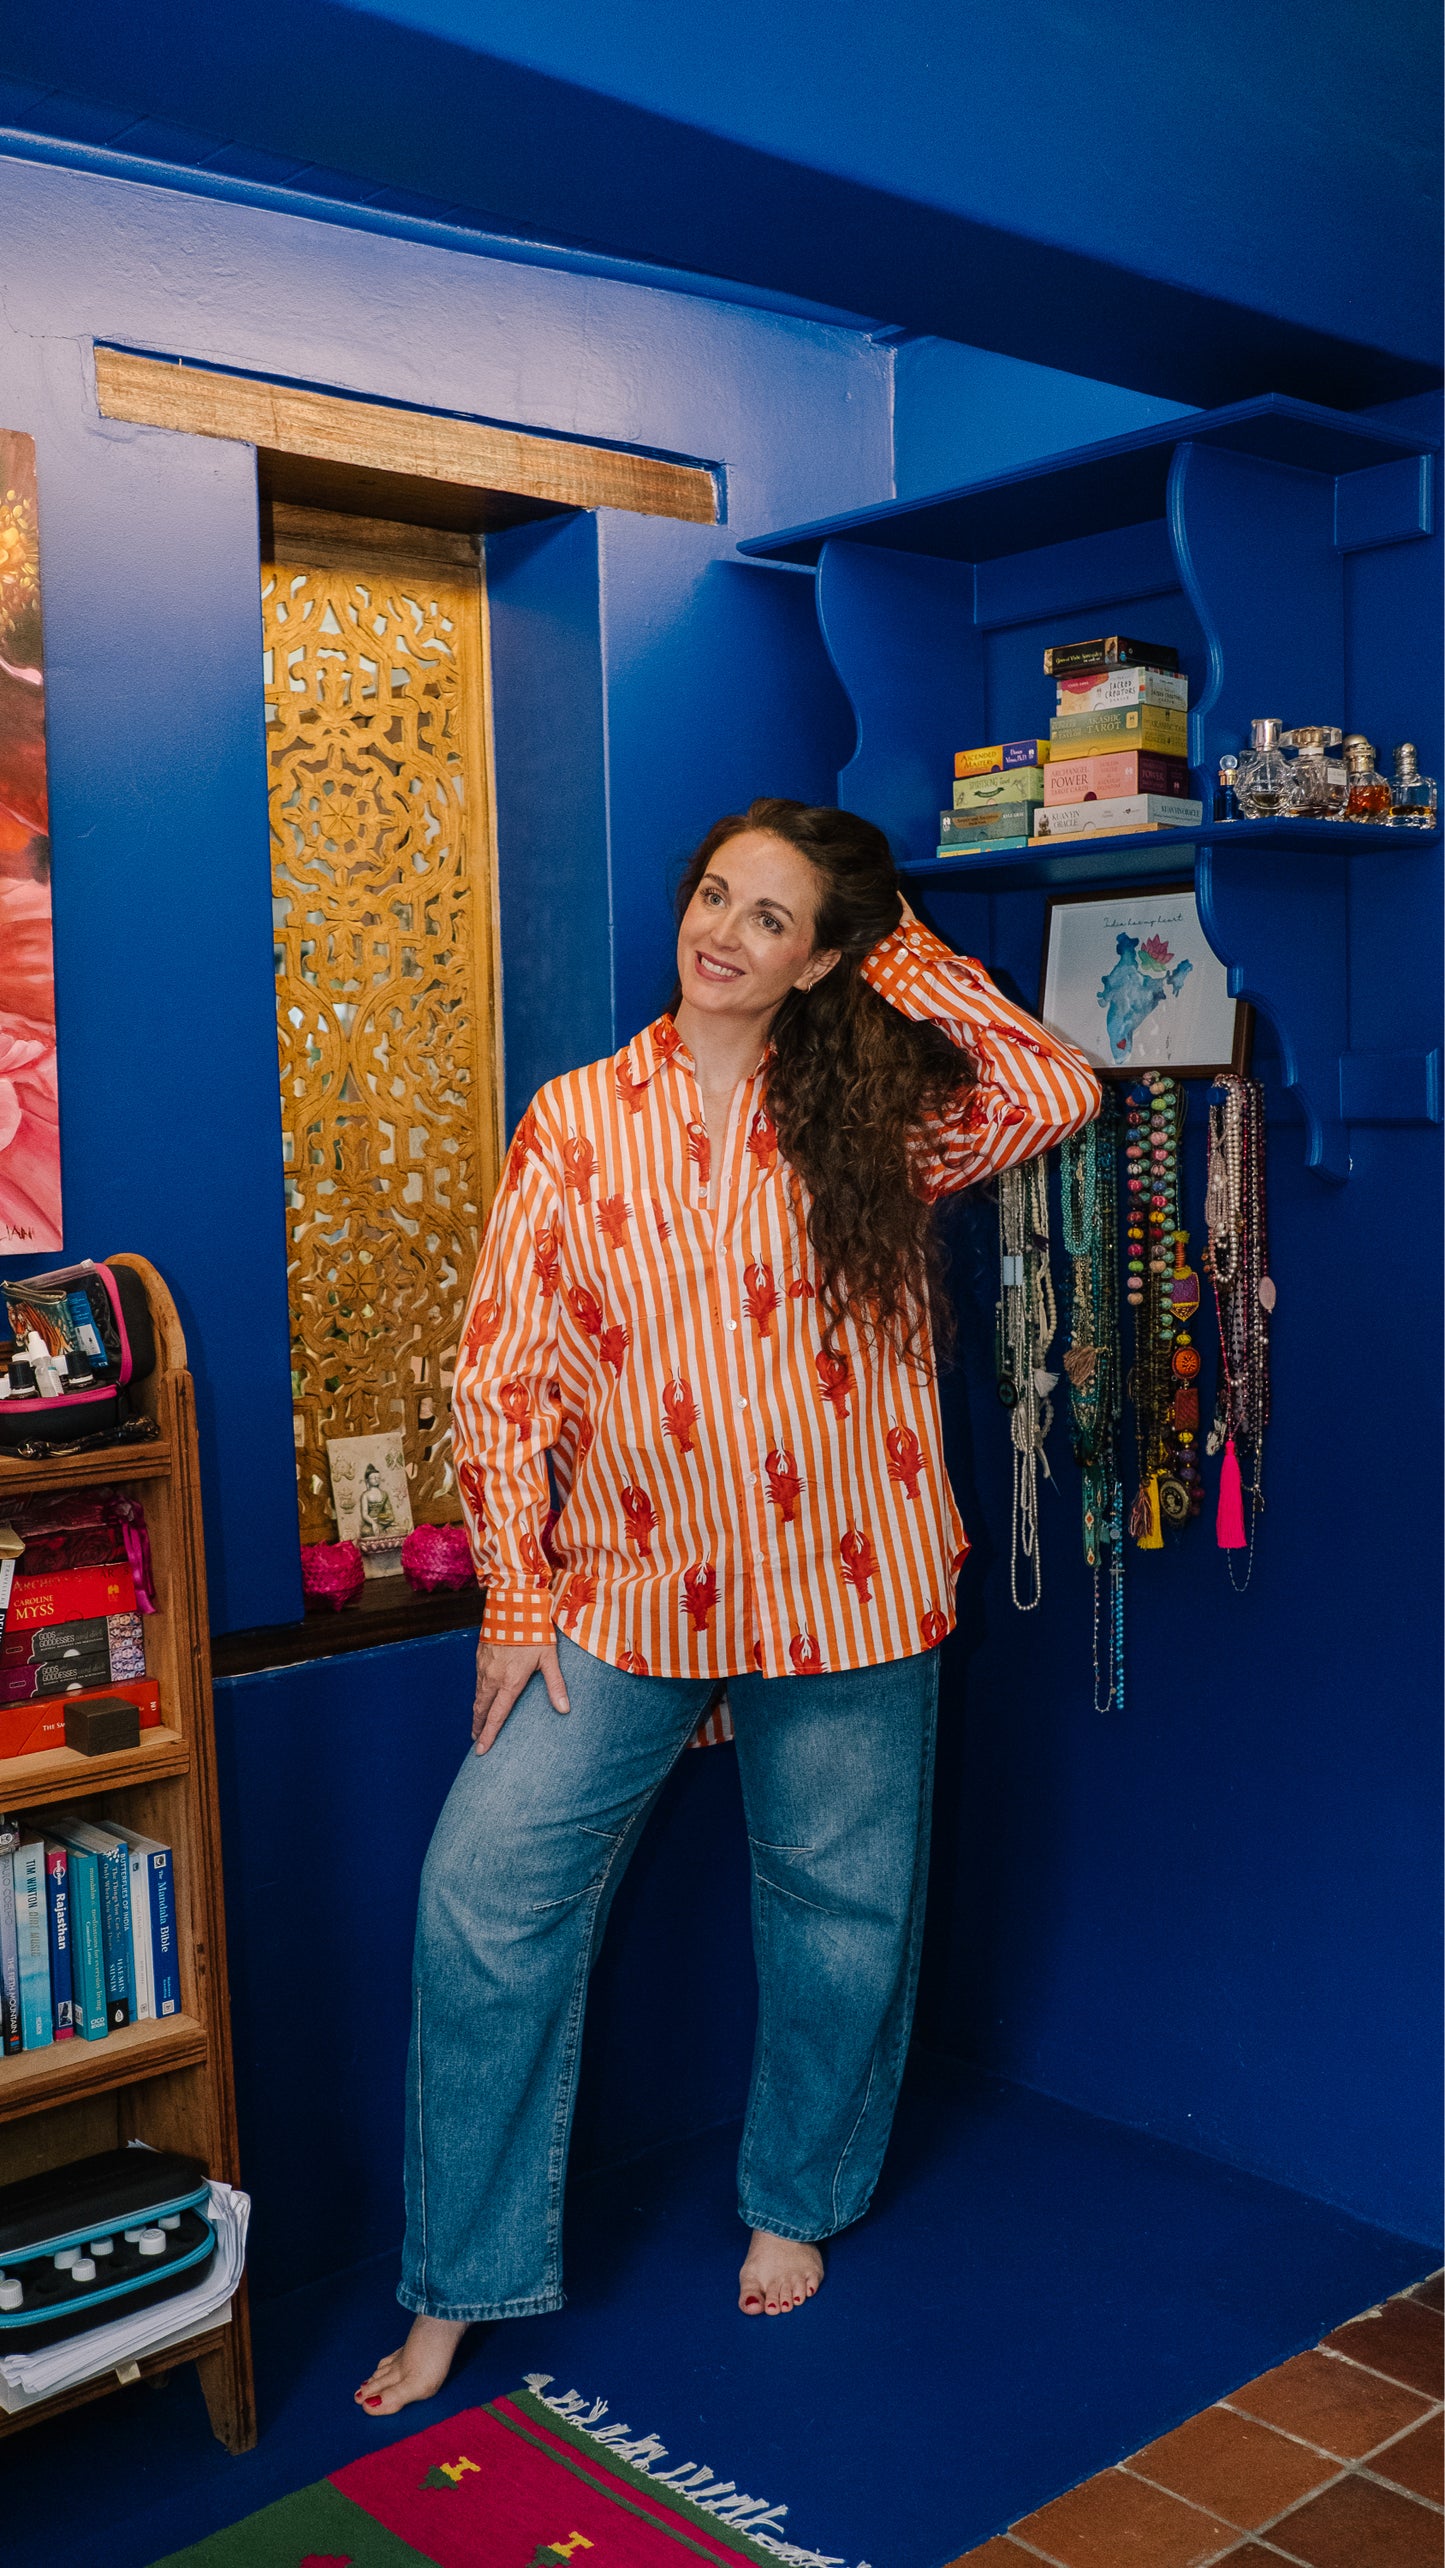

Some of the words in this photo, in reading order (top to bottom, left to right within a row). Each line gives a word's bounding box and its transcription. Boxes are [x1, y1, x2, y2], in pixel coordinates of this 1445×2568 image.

[1105, 687, 1136, 699] CREATORS
[1110, 681, 1132, 690] SACRED
[1086, 722, 1121, 733] TAROT
[961, 752, 996, 762] ASCENDED
[964, 759, 993, 768] MASTERS
[1052, 766, 1089, 776] ARCHANGEL
[1051, 774, 1088, 789] POWER
[1104, 917, 1123, 927] India
[14, 1595, 54, 1606] CAROLINE
[16, 1604, 54, 1620] MYSS
[39, 1632, 56, 1640] GODS
[39, 1635, 75, 1647] GODDESSES
[42, 1666, 59, 1675] GODS
[43, 1669, 77, 1681] GODDESSES
[1, 1857, 13, 1886] PAULO
[26, 1859, 36, 1875] TIM
[27, 1877, 38, 1908] WINTON
[111, 1880, 120, 1904] Things
[3, 1889, 13, 1926] COELHO
[122, 1900, 129, 1911] OF
[157, 1882, 168, 1925] Mandala
[28, 1911, 39, 1929] DIRT
[54, 1893, 67, 1950] Rajasthan
[91, 1909, 99, 1949] meditations
[30, 1932, 41, 1958] MUSIC
[159, 1926, 170, 1953] Bible
[8, 1973, 16, 1992] FIFTH
[93, 1959, 102, 1990] everyday
[109, 1963, 117, 1992] SUNIM
[117, 1958, 125, 1993] HAEMIN
[9, 1992, 18, 2034] MOUNTAIN
